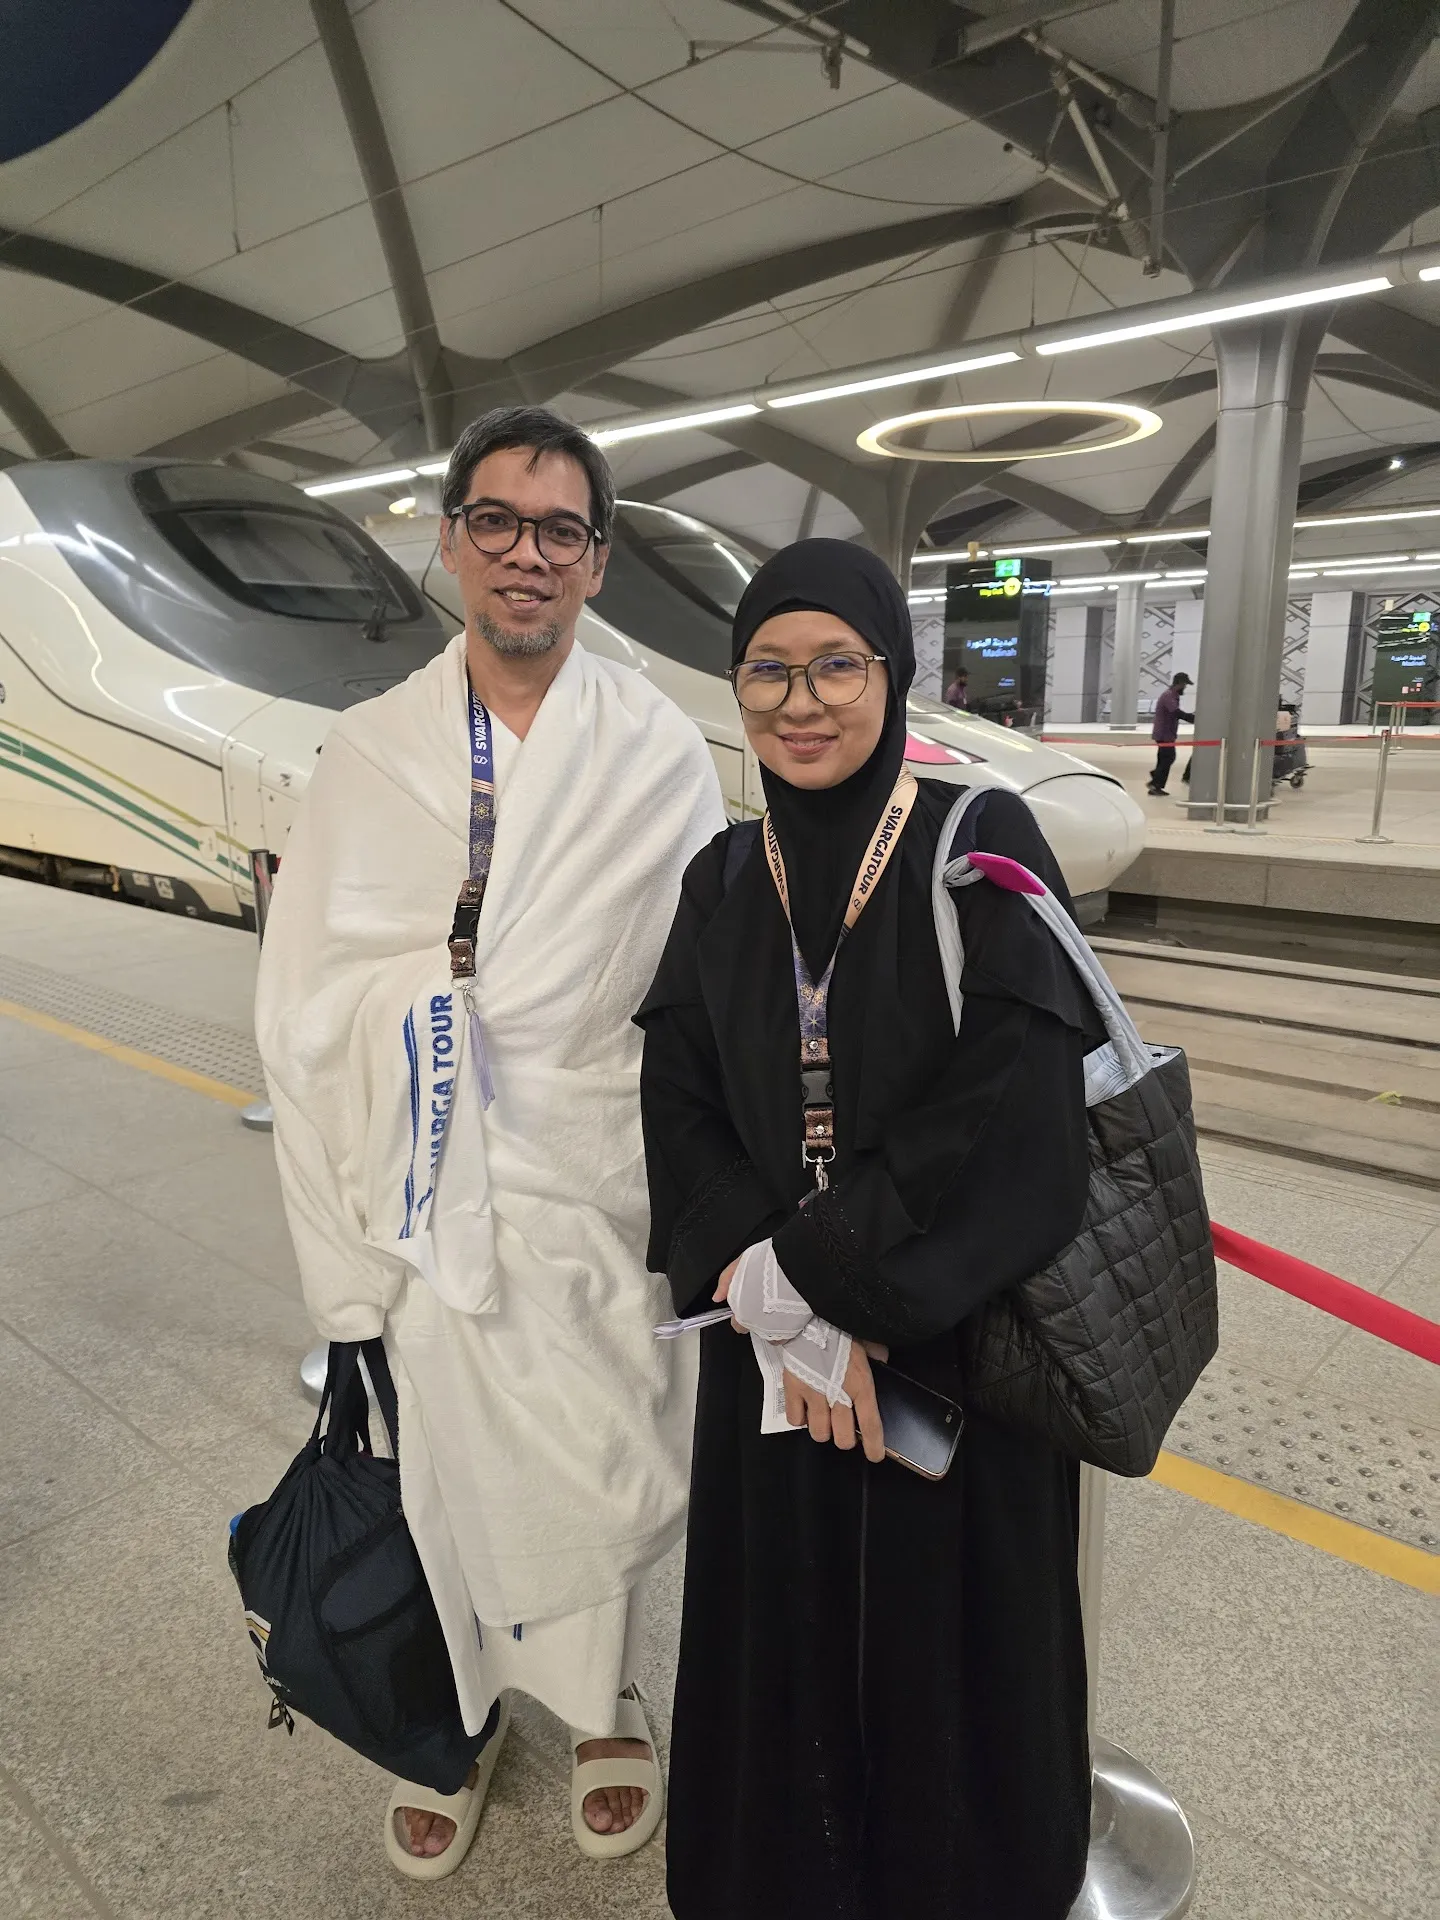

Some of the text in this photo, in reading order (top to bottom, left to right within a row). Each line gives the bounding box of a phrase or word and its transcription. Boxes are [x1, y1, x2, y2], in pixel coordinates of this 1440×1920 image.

[472, 687, 487, 750] SVARGATO
[858, 805, 903, 895] SVARGATOUR
[430, 992, 454, 1073] TOUR
